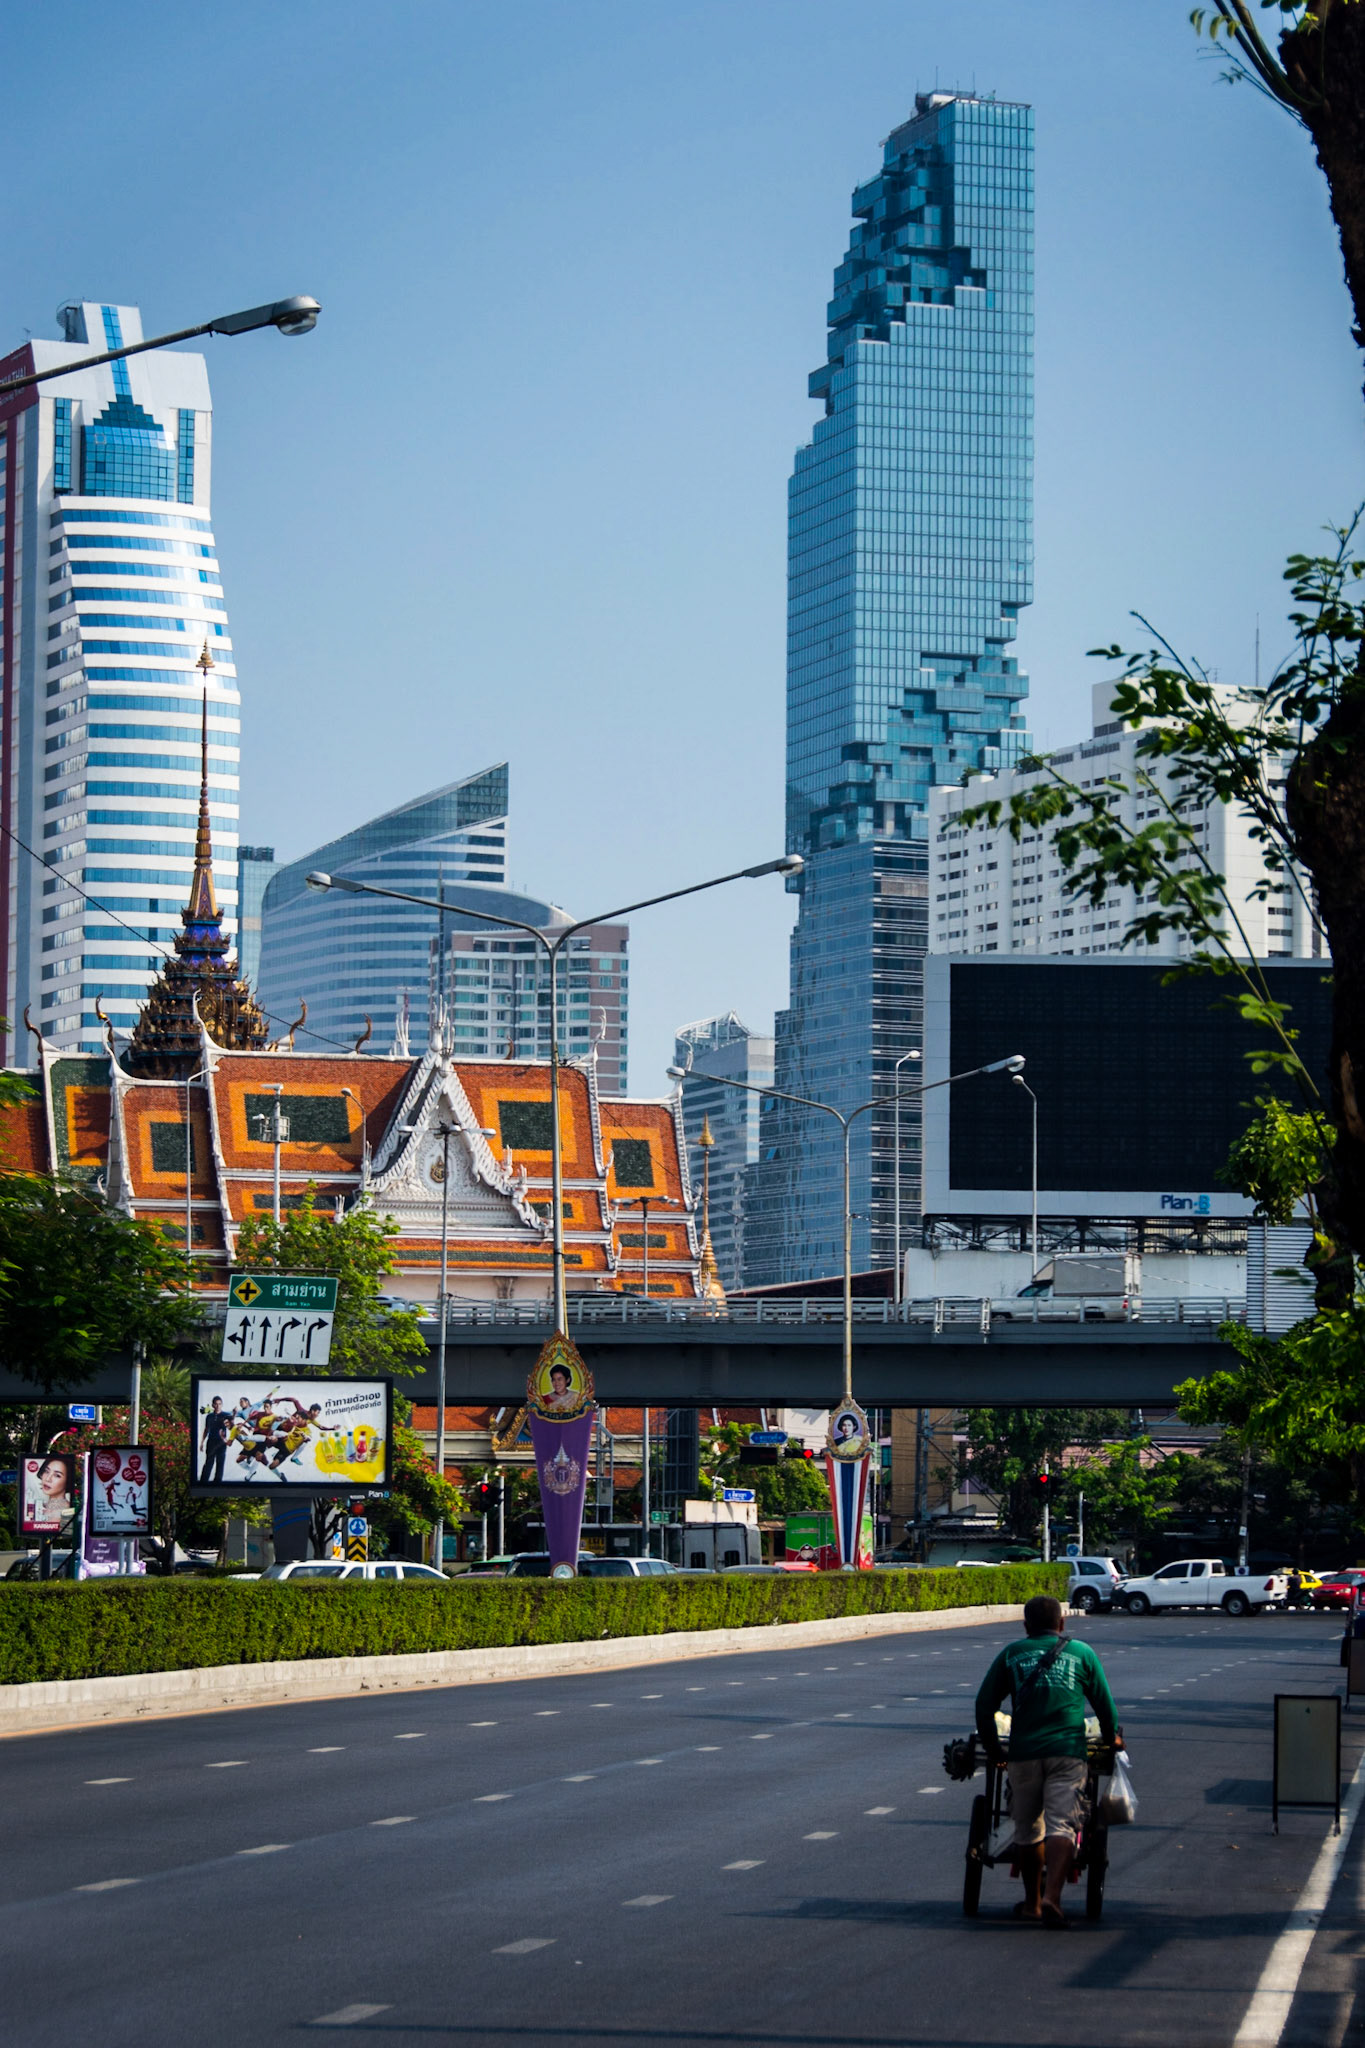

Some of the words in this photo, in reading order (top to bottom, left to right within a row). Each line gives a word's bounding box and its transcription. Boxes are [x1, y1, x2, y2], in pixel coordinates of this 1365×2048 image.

[1161, 1194, 1193, 1209] Plan
[272, 1282, 326, 1298] สามย่าน
[368, 1490, 384, 1498] Plan
